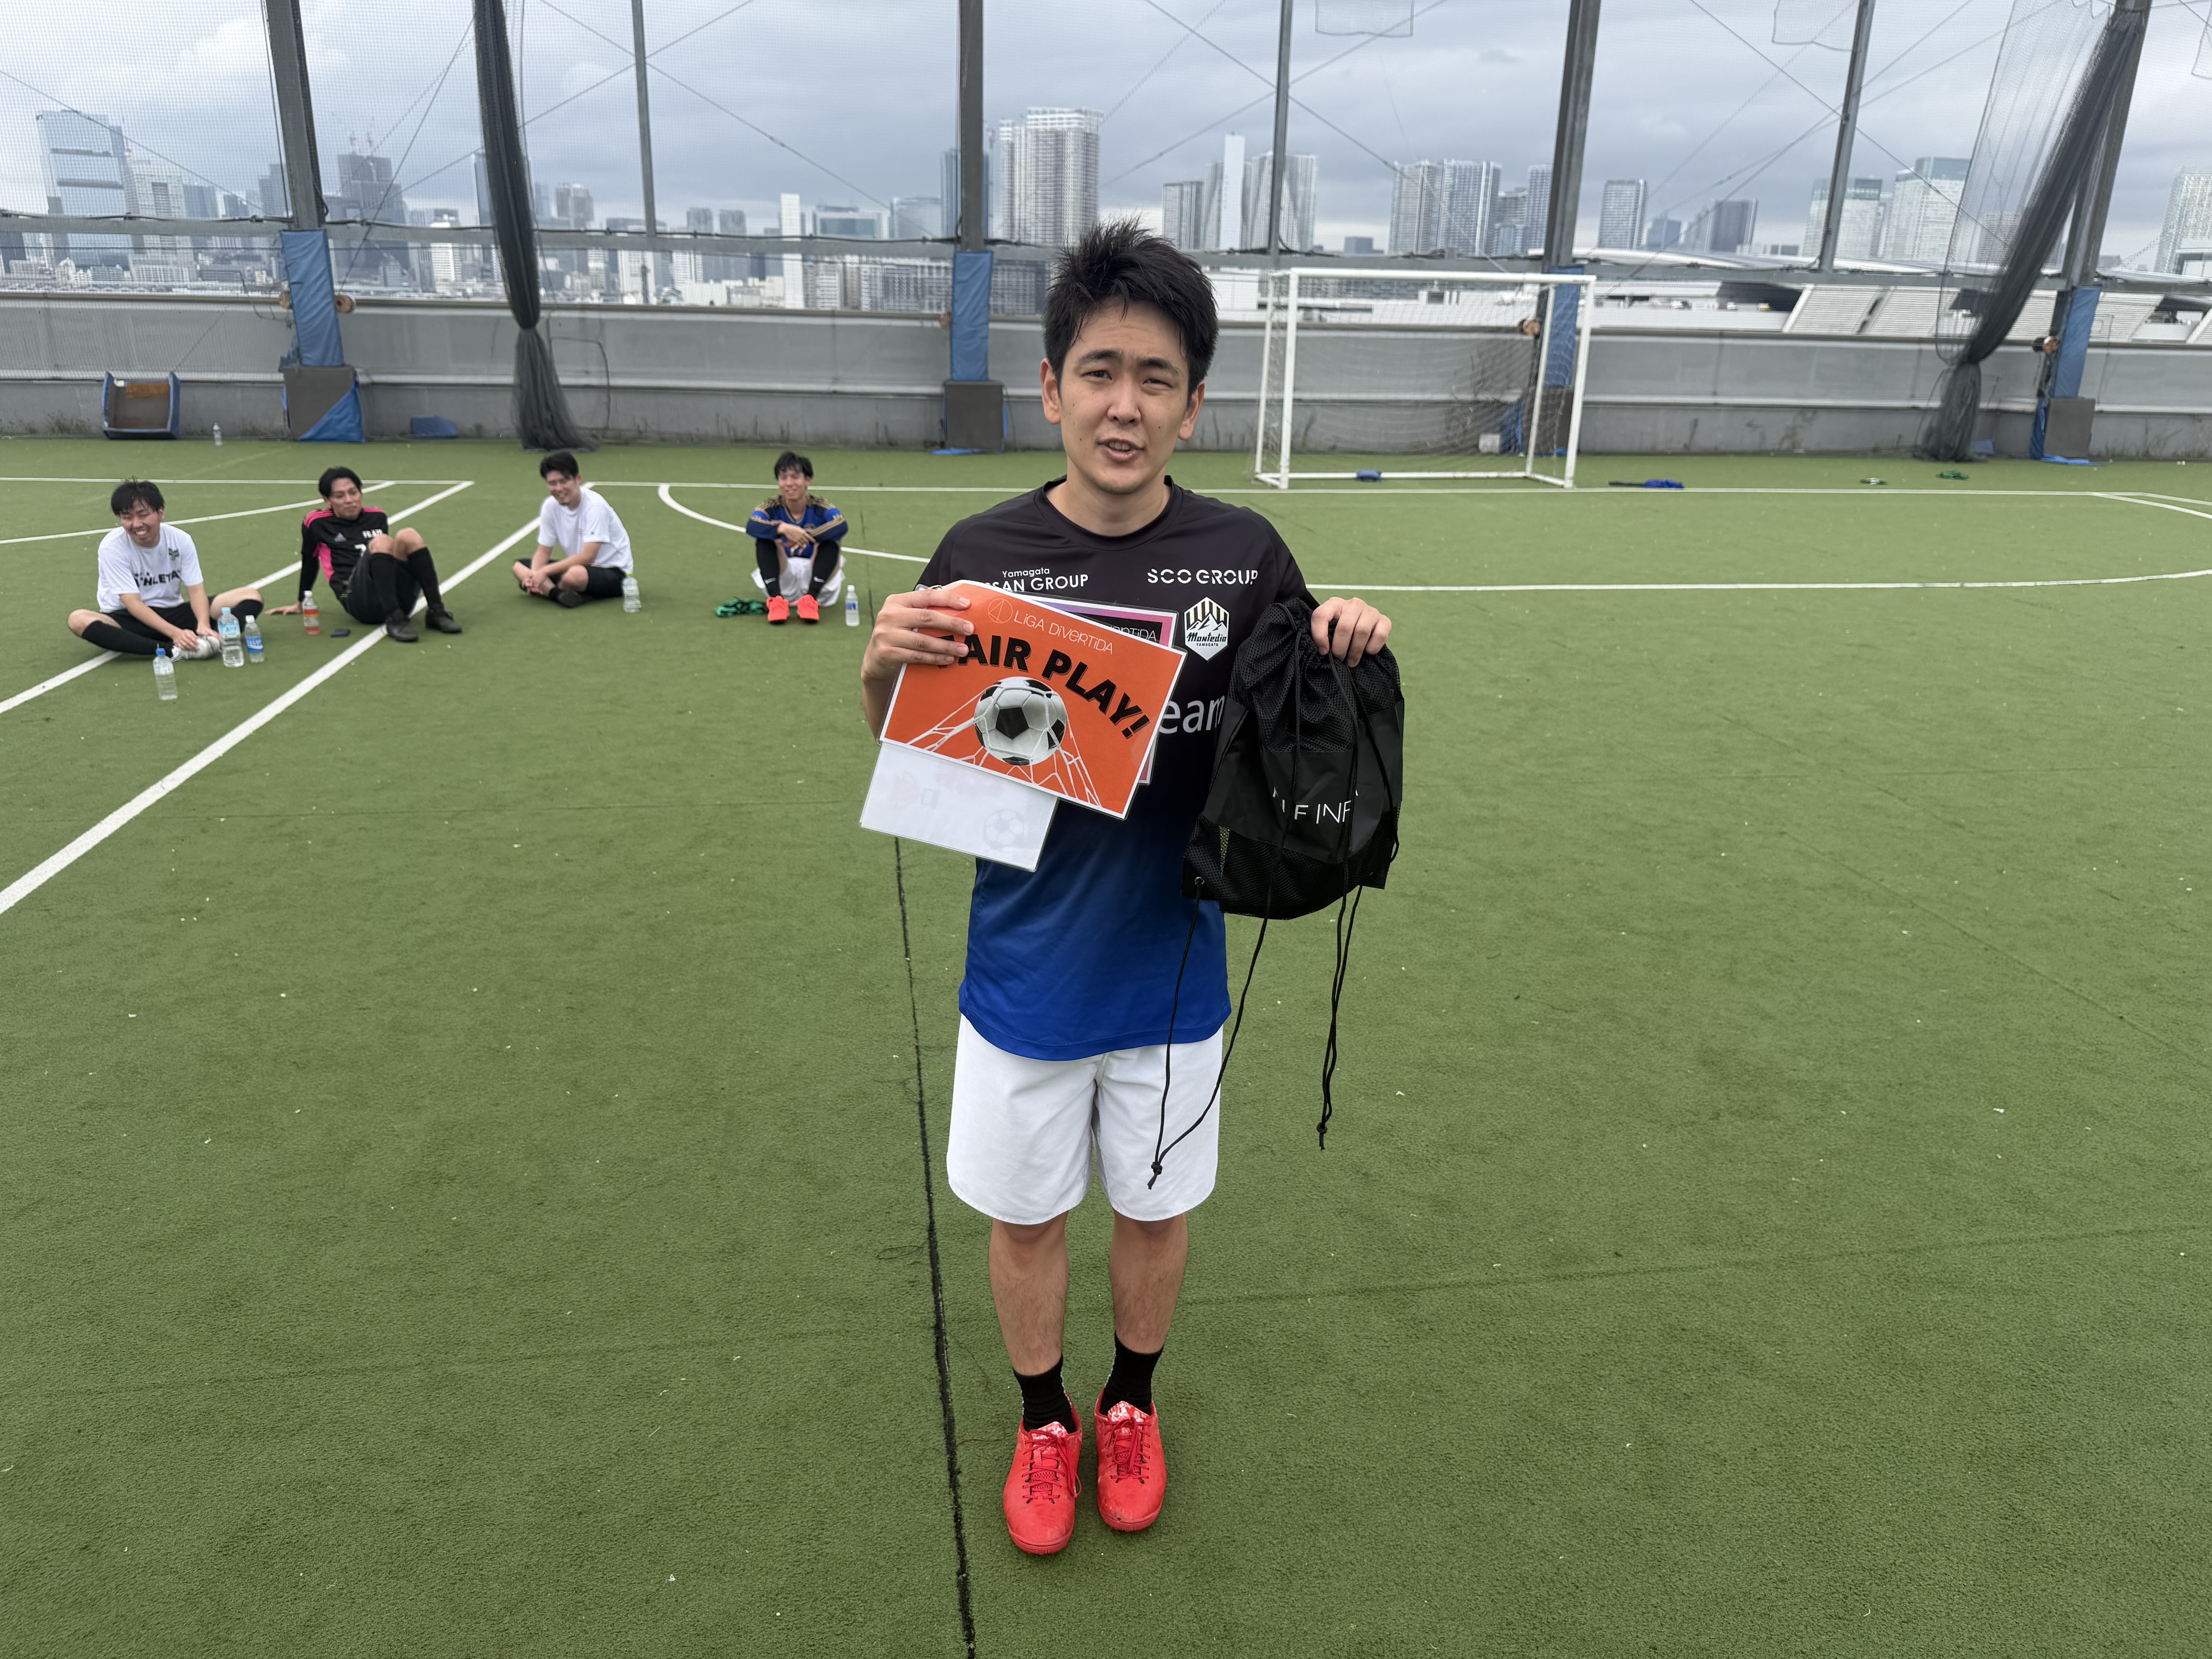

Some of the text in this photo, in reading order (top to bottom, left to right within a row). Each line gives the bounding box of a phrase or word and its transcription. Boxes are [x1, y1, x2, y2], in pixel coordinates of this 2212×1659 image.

[1002, 567, 1050, 578] Yamagata
[1147, 568, 1258, 585] SCO GROUP
[1030, 574, 1089, 591] GROUP
[1186, 632, 1227, 642] Montedio
[935, 634, 1150, 739] AIR PLAY!
